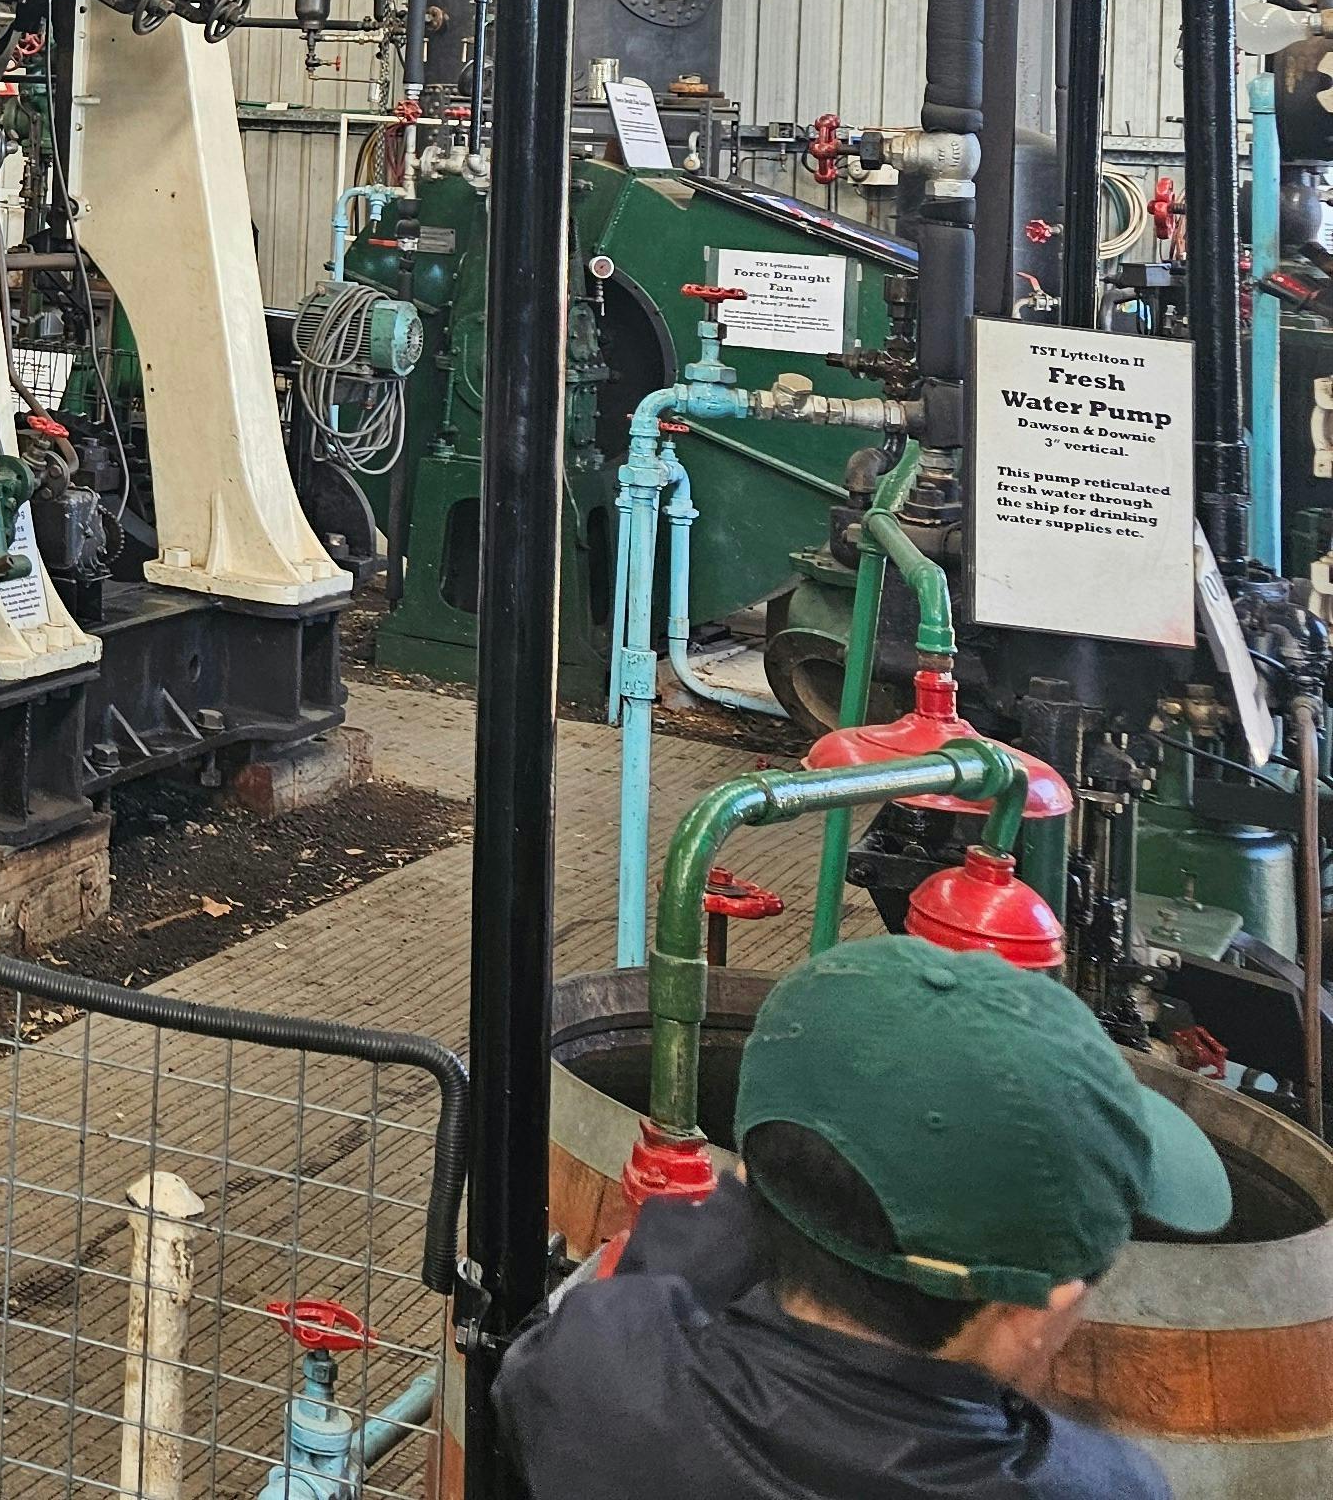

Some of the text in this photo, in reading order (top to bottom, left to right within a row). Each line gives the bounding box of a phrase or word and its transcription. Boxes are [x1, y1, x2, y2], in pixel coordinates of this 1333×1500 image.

[733, 268, 831, 284] Force Draught
[769, 283, 793, 292] Fan
[1030, 345, 1145, 367] TST Lyttelton II
[1048, 366, 1126, 391] Fresh
[1001, 389, 1172, 430] Water Pump
[1017, 417, 1156, 443] Dawson & Downie
[1064, 441, 1129, 457] vertical.
[997, 466, 1171, 496] This pump reticulated
[997, 481, 1153, 510] fresh water through
[996, 496, 1158, 527] the ship for drinking
[996, 513, 1144, 539] water supplies etc.
